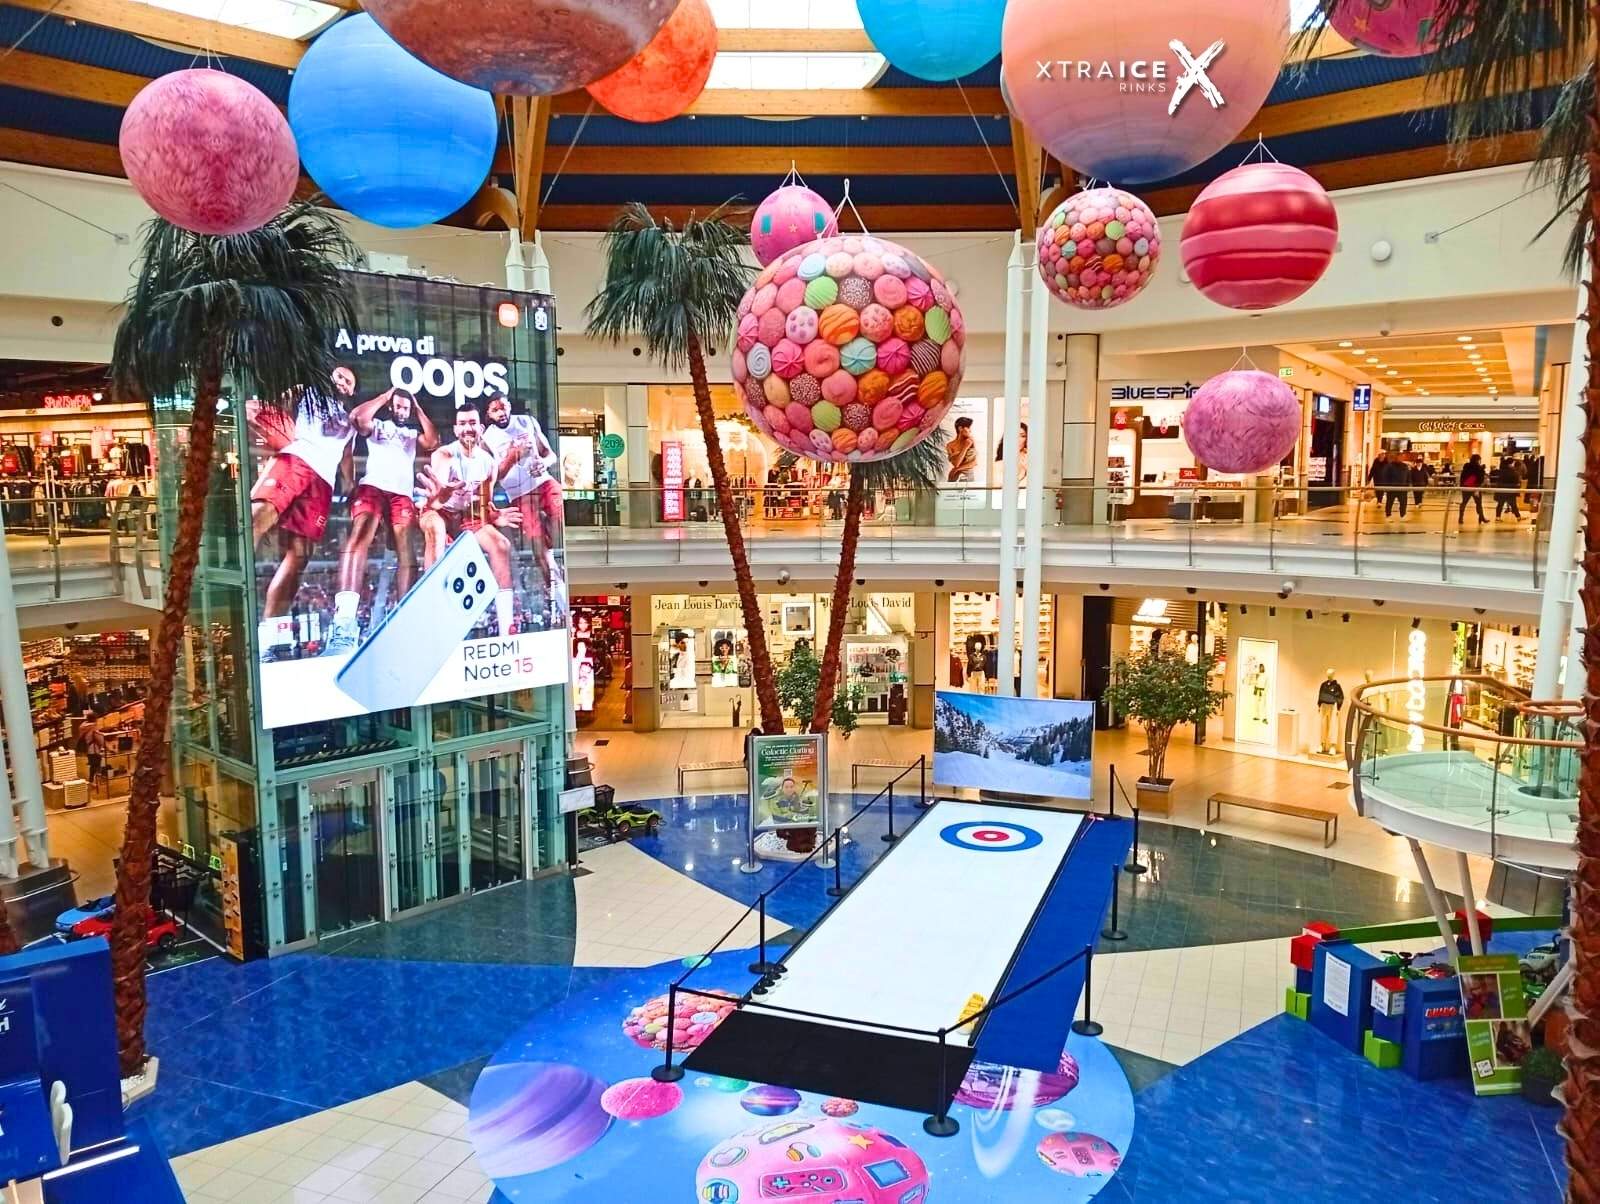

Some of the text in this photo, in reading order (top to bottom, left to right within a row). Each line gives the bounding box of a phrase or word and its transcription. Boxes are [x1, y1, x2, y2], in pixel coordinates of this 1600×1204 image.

[335, 328, 434, 356] A prova di
[390, 355, 509, 410] oops
[654, 599, 680, 610] Jean
[683, 598, 712, 610] Louis
[851, 596, 912, 609] Louis David
[463, 639, 520, 661] REDMI
[464, 657, 534, 682] Note 15
